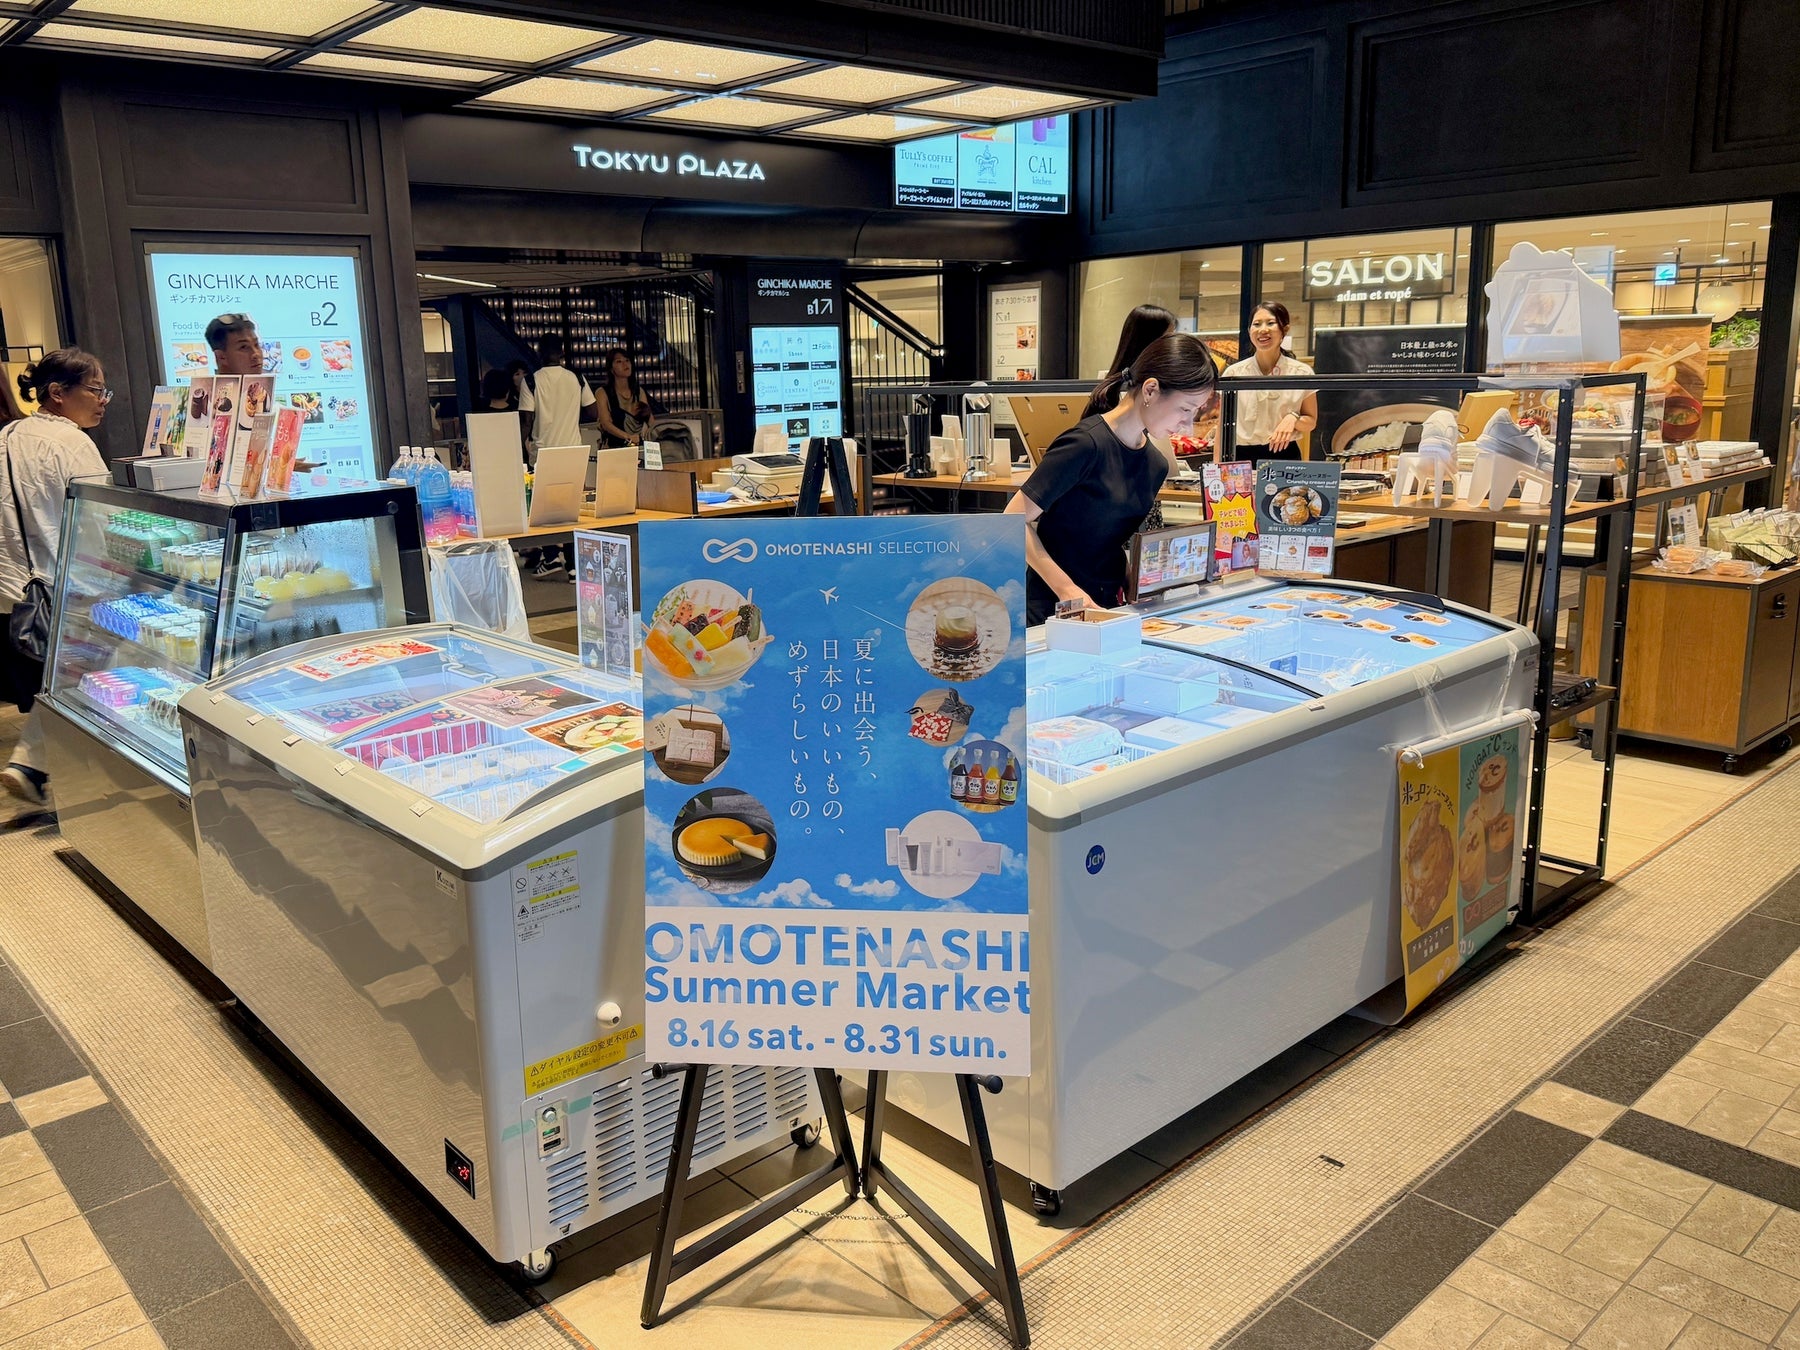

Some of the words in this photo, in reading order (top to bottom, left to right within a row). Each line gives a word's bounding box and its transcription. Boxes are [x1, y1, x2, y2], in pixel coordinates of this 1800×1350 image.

[573, 145, 669, 173] TOKYU
[678, 154, 765, 181] PLAZA
[927, 153, 953, 163] COFFEE
[1028, 155, 1057, 174] CAL
[1032, 176, 1052, 185] kitchen
[1310, 252, 1444, 287] SALON
[168, 273, 260, 290] GINCHIKA
[265, 274, 340, 290] MARCHE
[757, 278, 798, 289] GINCHIKA
[798, 279, 832, 289] MARCHE
[169, 294, 242, 304] ギンチカマルシェ
[757, 289, 790, 297] ギンチカマルシェ
[1336, 289, 1367, 302] adam
[1369, 289, 1382, 300] et
[1384, 286, 1412, 302] ropé
[310, 301, 339, 327] B2
[807, 298, 819, 315] B1
[172, 321, 193, 330] Food
[765, 542, 872, 556] OMOTENASHI
[878, 540, 960, 554] SELECTION
[852, 637, 878, 782] 夏に出会う、
[788, 639, 813, 835] めずらしいもの。
[820, 638, 845, 835] 日本のいいもの、
[645, 922, 1030, 973] OMOTENASHI
[645, 965, 839, 1007] Summer
[856, 971, 1030, 1015] Market
[667, 1017, 740, 1048] 8.16
[748, 1023, 815, 1051] sat.
[844, 1023, 921, 1056] 8.31
[929, 1033, 1007, 1059] sun.
